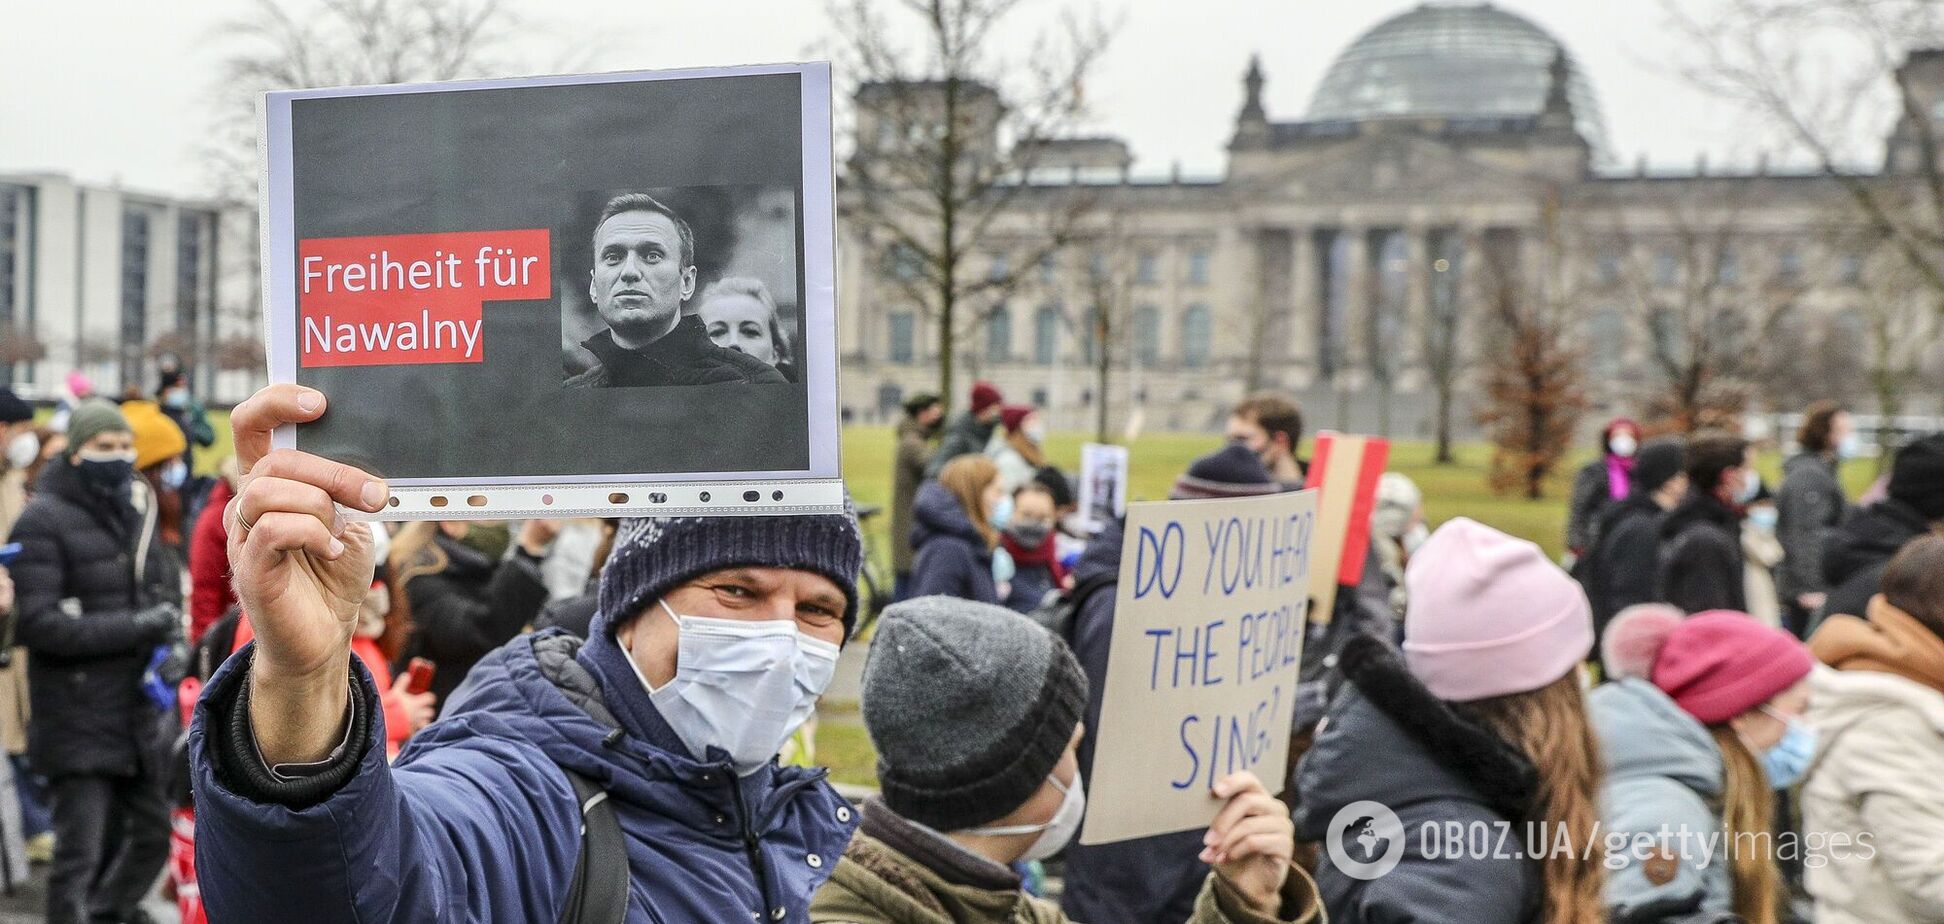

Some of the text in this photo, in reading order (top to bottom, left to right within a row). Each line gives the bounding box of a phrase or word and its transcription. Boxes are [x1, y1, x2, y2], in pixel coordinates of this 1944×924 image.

[303, 246, 539, 294] Freiheit für
[303, 308, 483, 358] Nawalny
[1135, 521, 1185, 599] DO
[1203, 516, 1264, 596] YOU
[1145, 602, 1302, 690] THE PEOPLE
[1171, 685, 1281, 790] SING?
